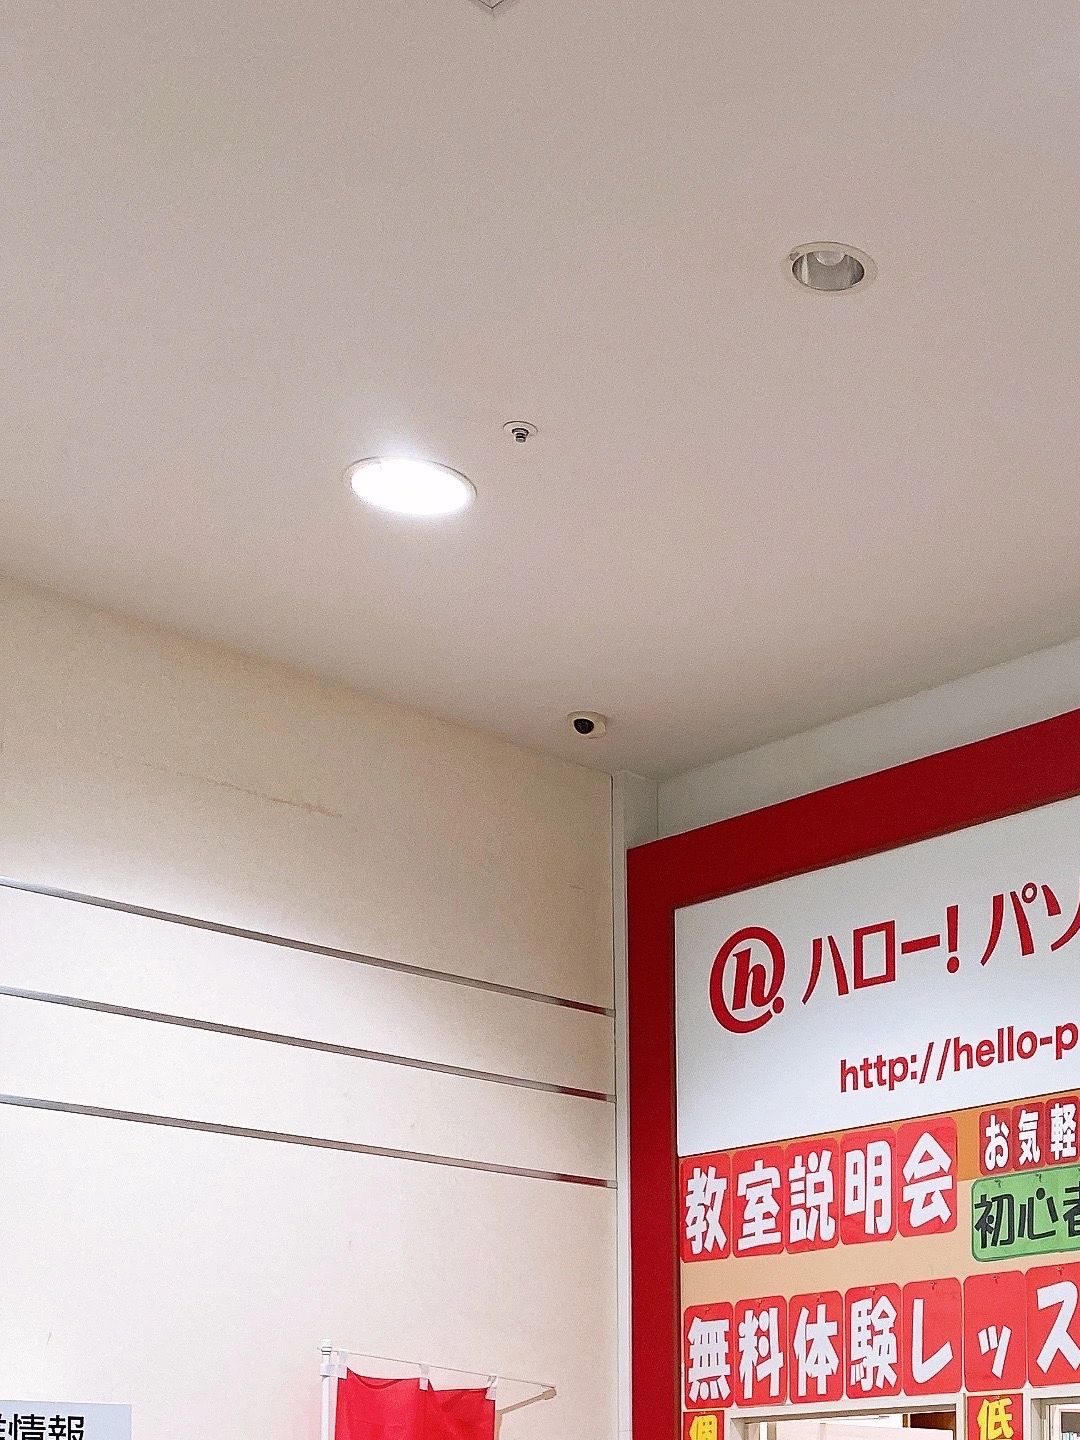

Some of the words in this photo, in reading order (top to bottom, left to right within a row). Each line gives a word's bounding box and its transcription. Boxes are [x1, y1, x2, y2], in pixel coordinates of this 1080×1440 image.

[685, 1135, 954, 1254] 教室説明会
